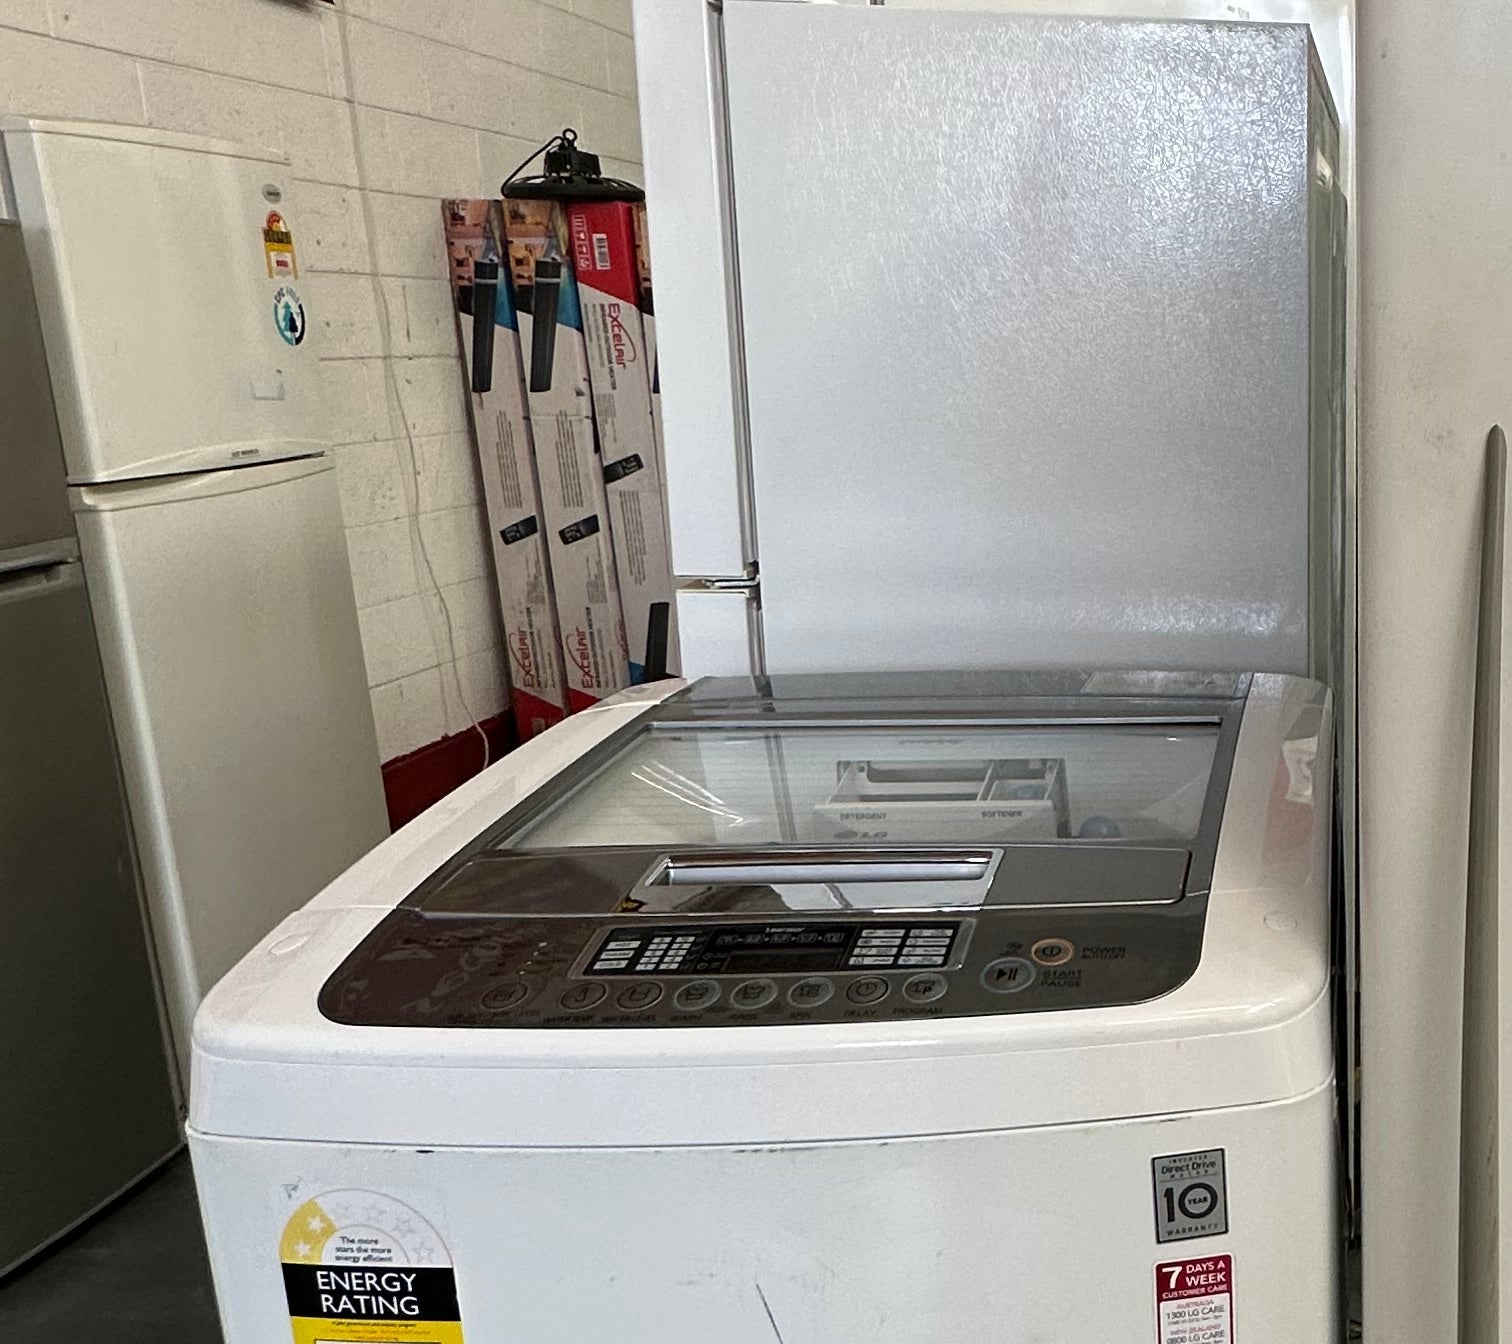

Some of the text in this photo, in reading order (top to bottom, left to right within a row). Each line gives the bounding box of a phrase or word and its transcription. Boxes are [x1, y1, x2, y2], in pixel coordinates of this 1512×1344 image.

[1161, 1161, 1217, 1175] Direct Drive
[1163, 1182, 1218, 1223] 10
[338, 1236, 355, 1244] The
[316, 1270, 417, 1293] ENERGY
[1162, 1260, 1226, 1289] 7 DAYS A
[1185, 1271, 1226, 1287] WEEK
[1162, 1284, 1228, 1299] CUSTOMER CARE
[320, 1293, 420, 1316] RATING
[1166, 1305, 1225, 1320] 1300 LG CARE
[1188, 1334, 1201, 1342] LG
[1202, 1329, 1225, 1340] CARE
